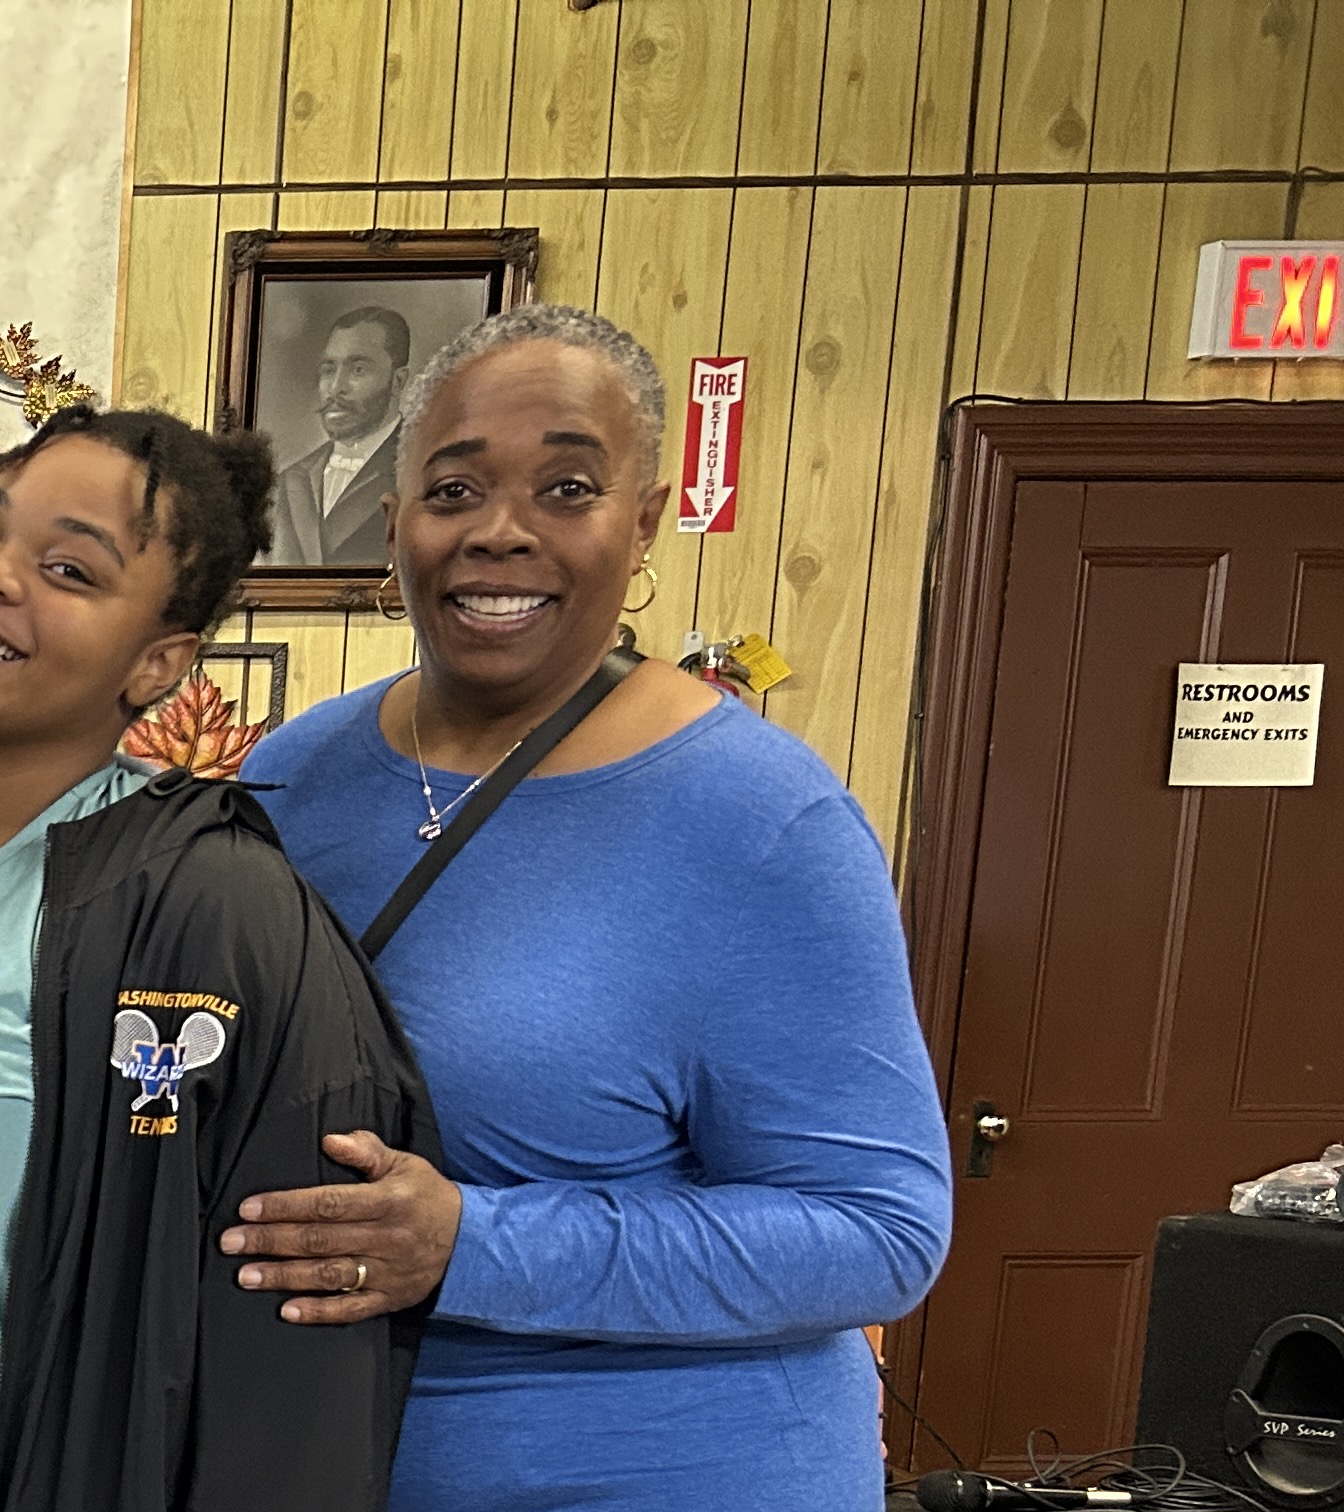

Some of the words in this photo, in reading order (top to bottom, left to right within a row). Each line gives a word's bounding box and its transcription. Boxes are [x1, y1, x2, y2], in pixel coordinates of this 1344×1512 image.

[1229, 256, 1340, 349] EXI
[698, 373, 738, 396] FIRE
[703, 401, 722, 516] EXTINGUISHER
[1182, 683, 1310, 702] RESTROOMS
[1222, 711, 1254, 723] AND
[1177, 727, 1260, 741] EMERGENCY
[1264, 728, 1309, 741] EXITS
[118, 990, 241, 1020] ASHINGTONVILLE
[1263, 1420, 1290, 1435] SVP
[1296, 1424, 1336, 1438] Series
